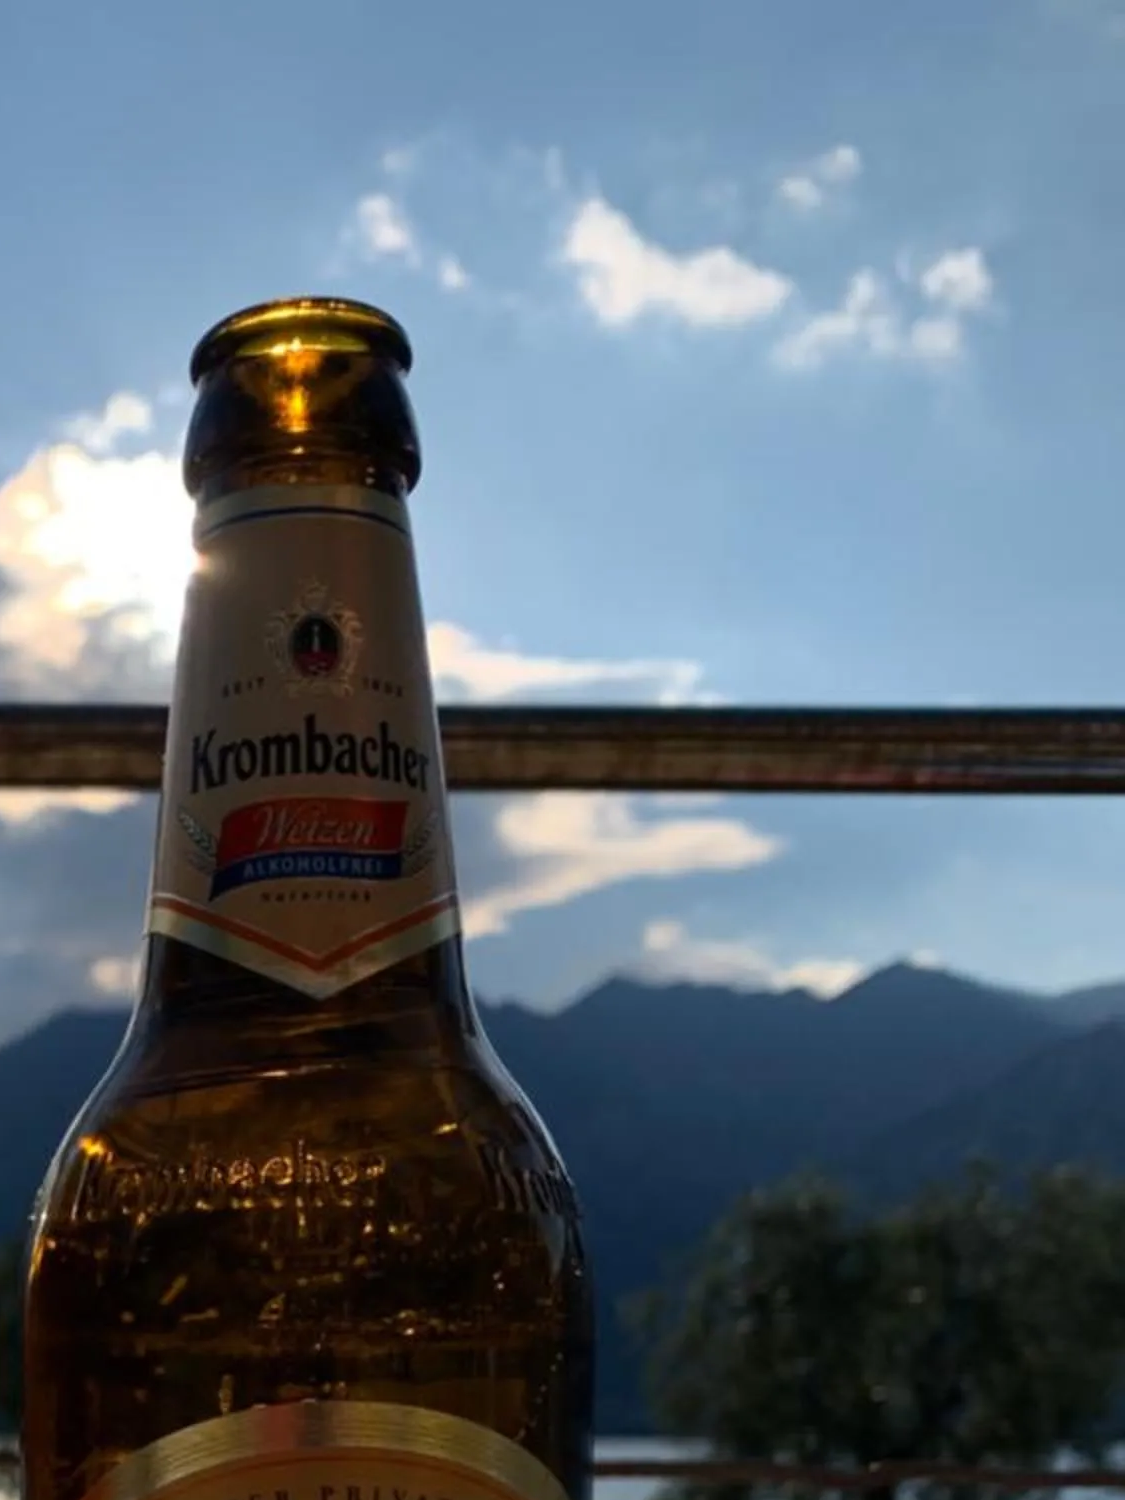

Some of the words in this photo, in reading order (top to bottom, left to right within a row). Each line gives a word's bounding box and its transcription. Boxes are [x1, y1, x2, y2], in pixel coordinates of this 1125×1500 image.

[190, 713, 429, 793] Krombacher
[253, 802, 374, 849] Weizen
[243, 856, 382, 877] ALKOHOLFREI
